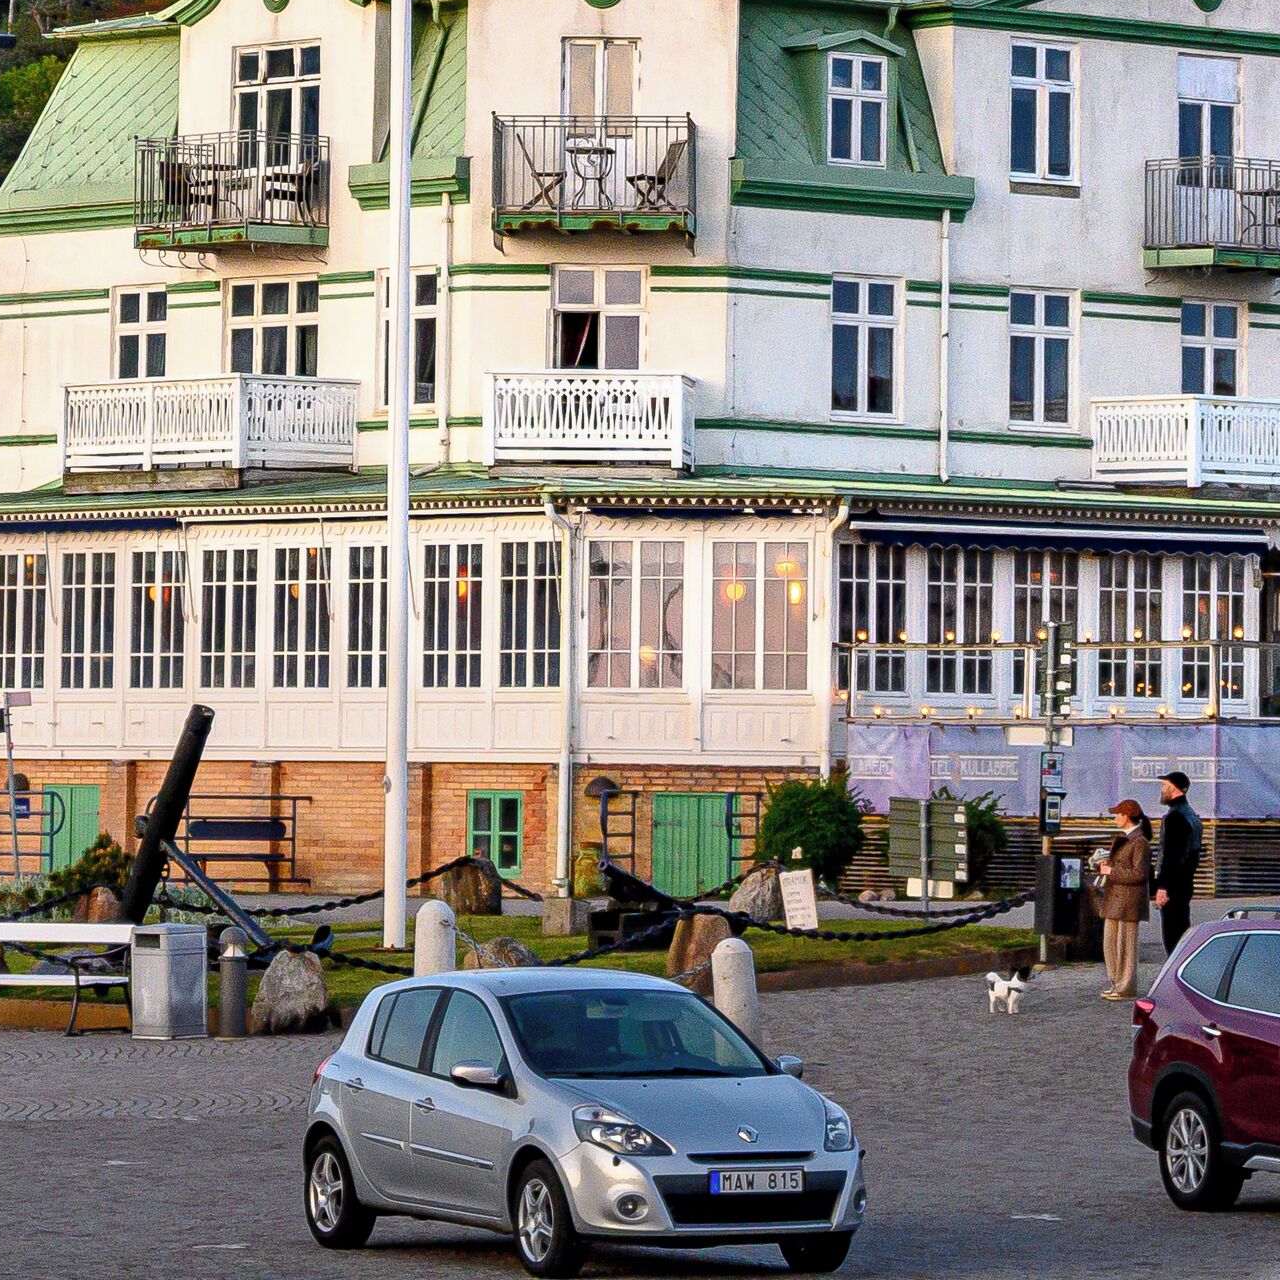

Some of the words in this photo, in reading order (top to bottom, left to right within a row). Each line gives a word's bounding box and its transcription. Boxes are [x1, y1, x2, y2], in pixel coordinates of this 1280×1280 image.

[931, 760, 952, 775] TEL
[722, 1173, 756, 1191] MAW
[768, 1172, 799, 1189] 815
